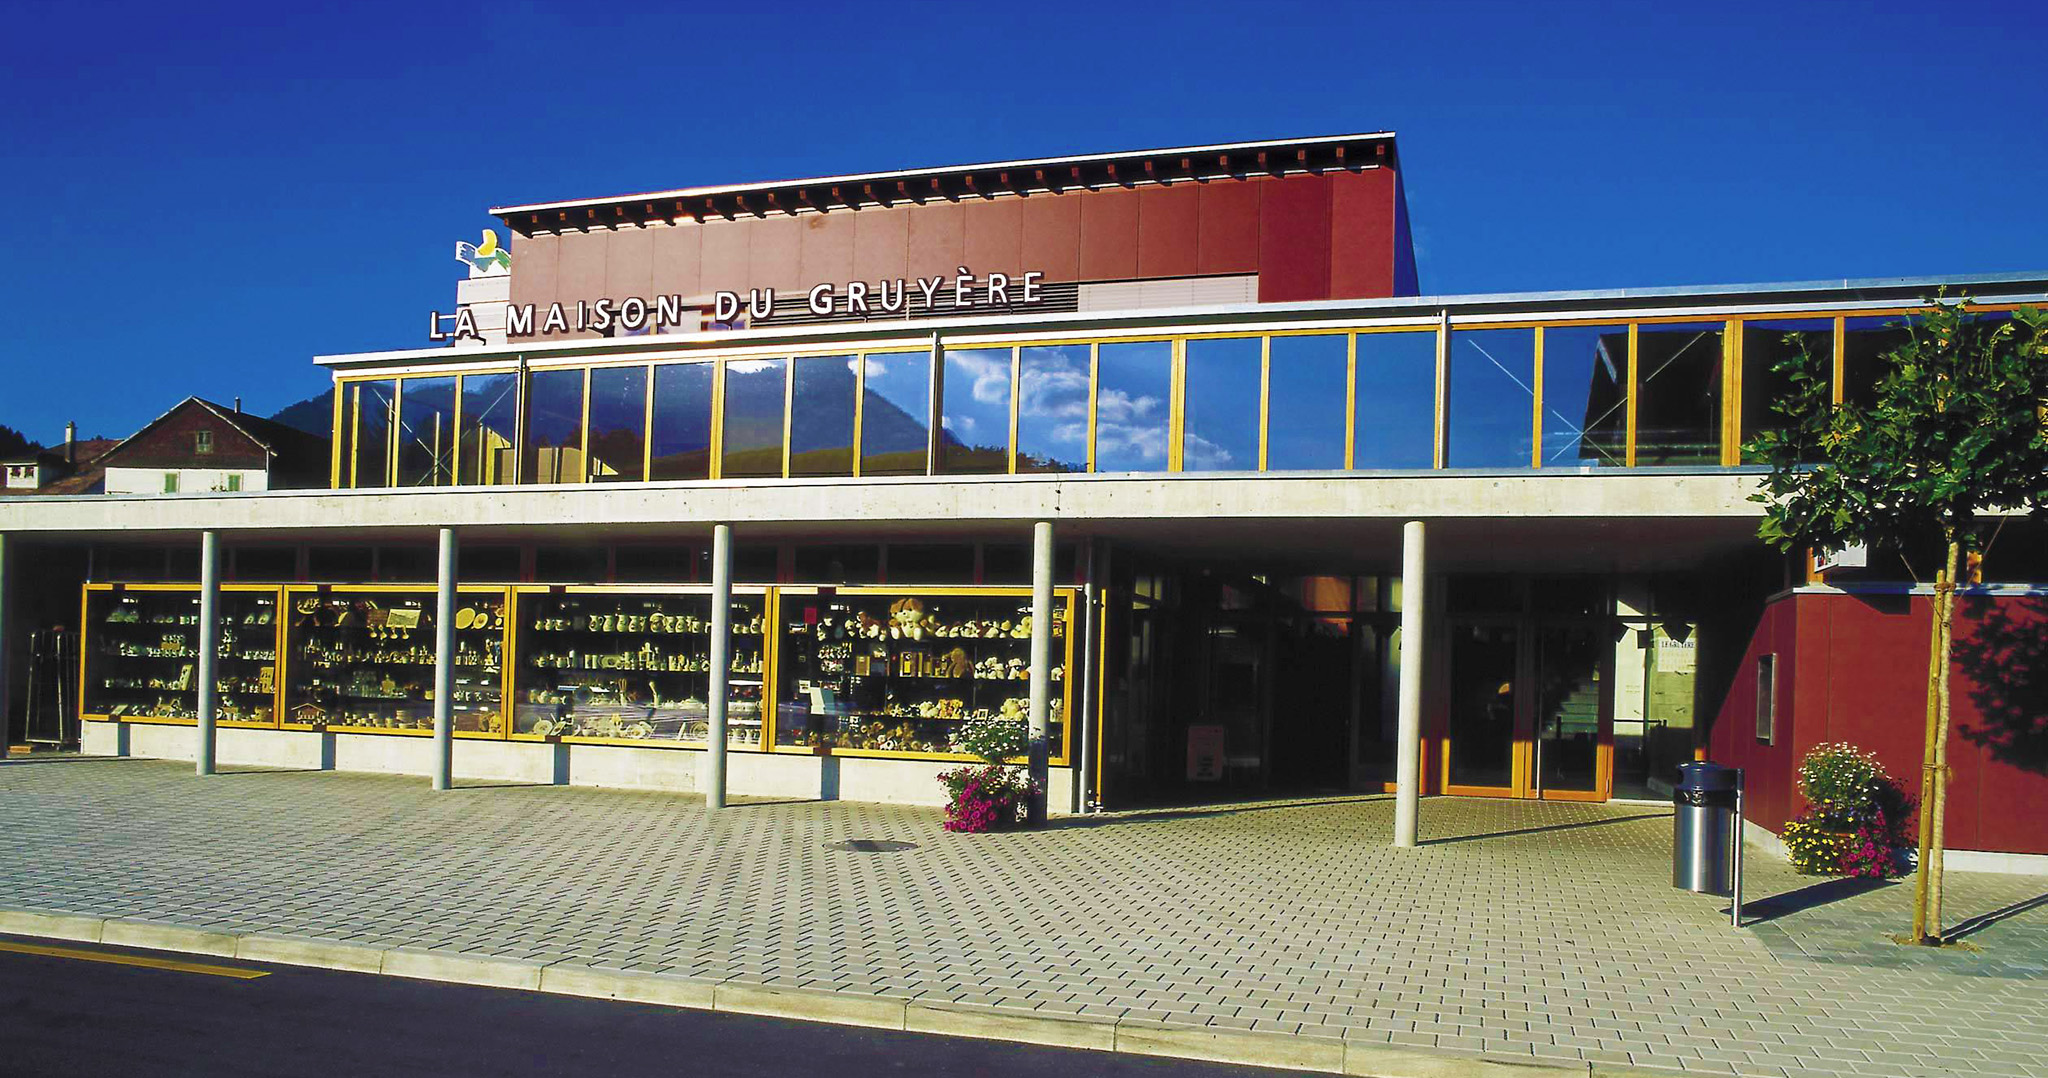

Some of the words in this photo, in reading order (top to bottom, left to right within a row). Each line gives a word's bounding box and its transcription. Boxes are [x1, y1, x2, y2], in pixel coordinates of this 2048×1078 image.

[430, 309, 481, 339] LA
[506, 294, 682, 337] MAISON
[715, 288, 773, 323] DU
[809, 266, 1045, 316] GRUYÈRE
